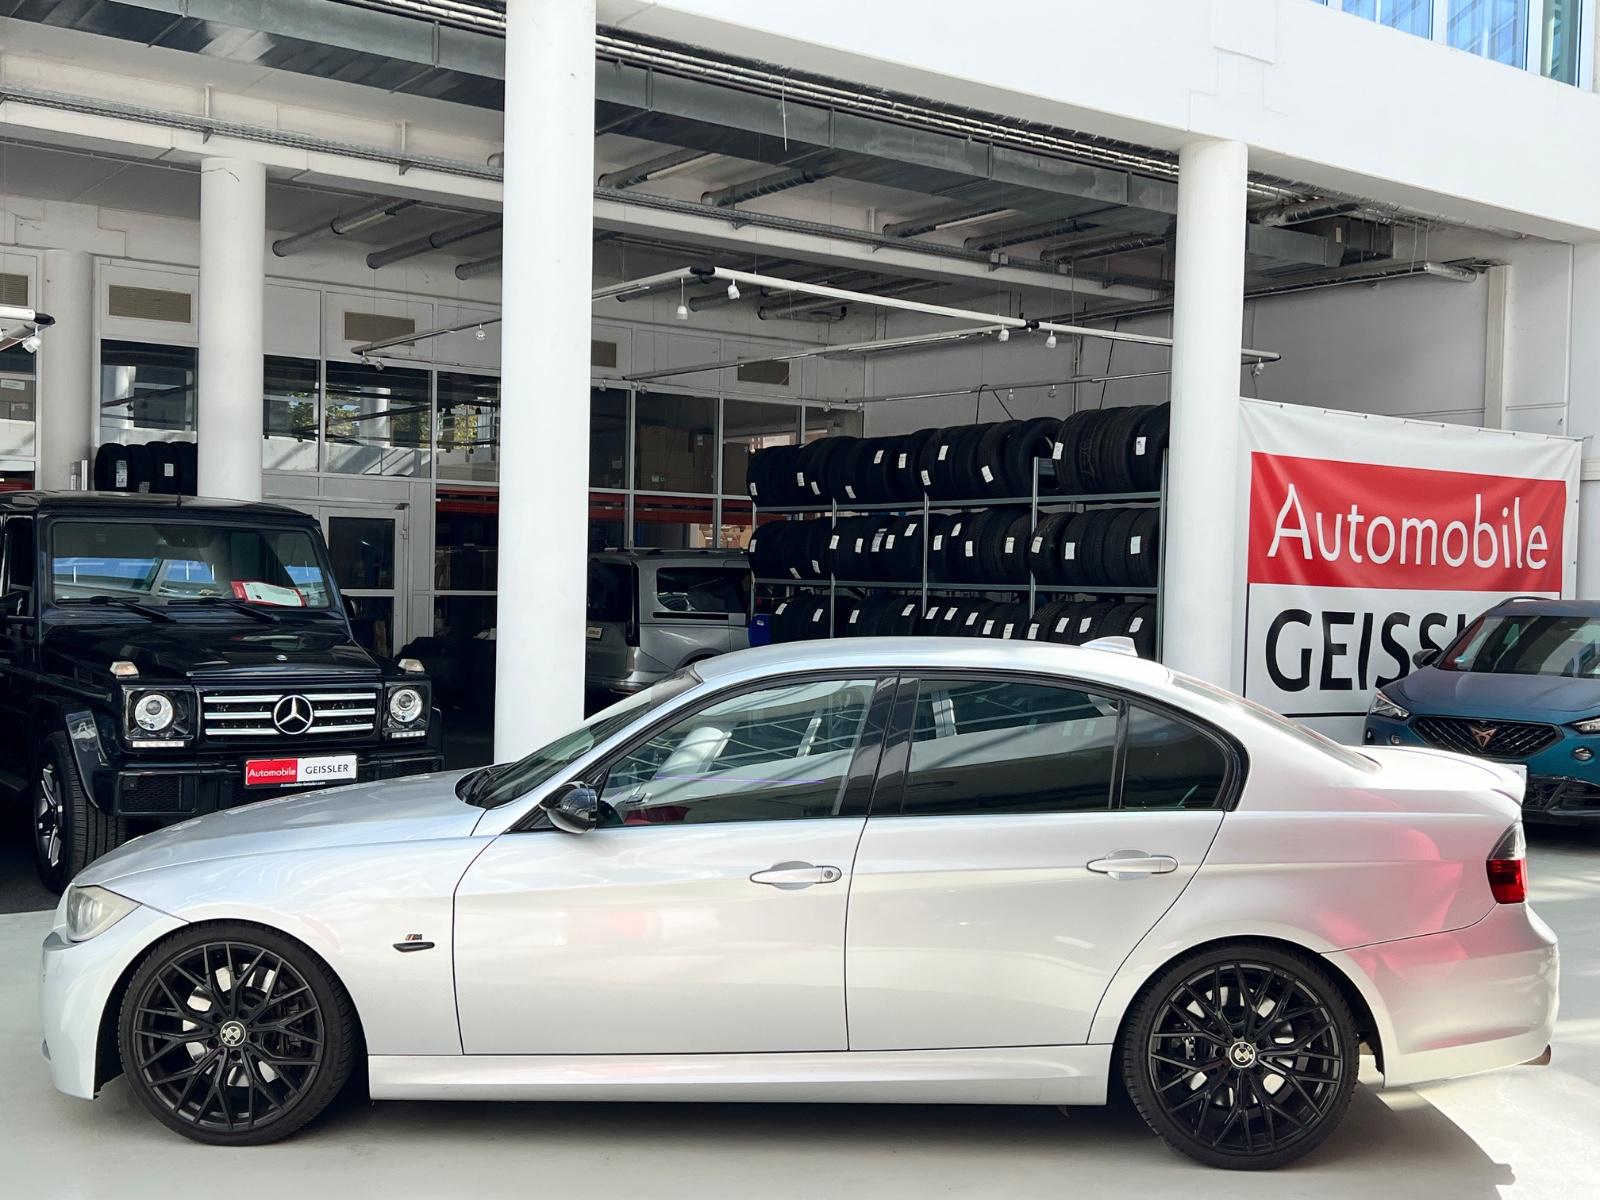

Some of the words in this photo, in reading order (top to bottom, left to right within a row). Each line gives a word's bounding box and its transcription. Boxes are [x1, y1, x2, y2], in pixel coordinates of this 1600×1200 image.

[1267, 483, 1548, 570] Automobile
[248, 767, 296, 778] Automobile
[305, 764, 349, 775] GEISSLER
